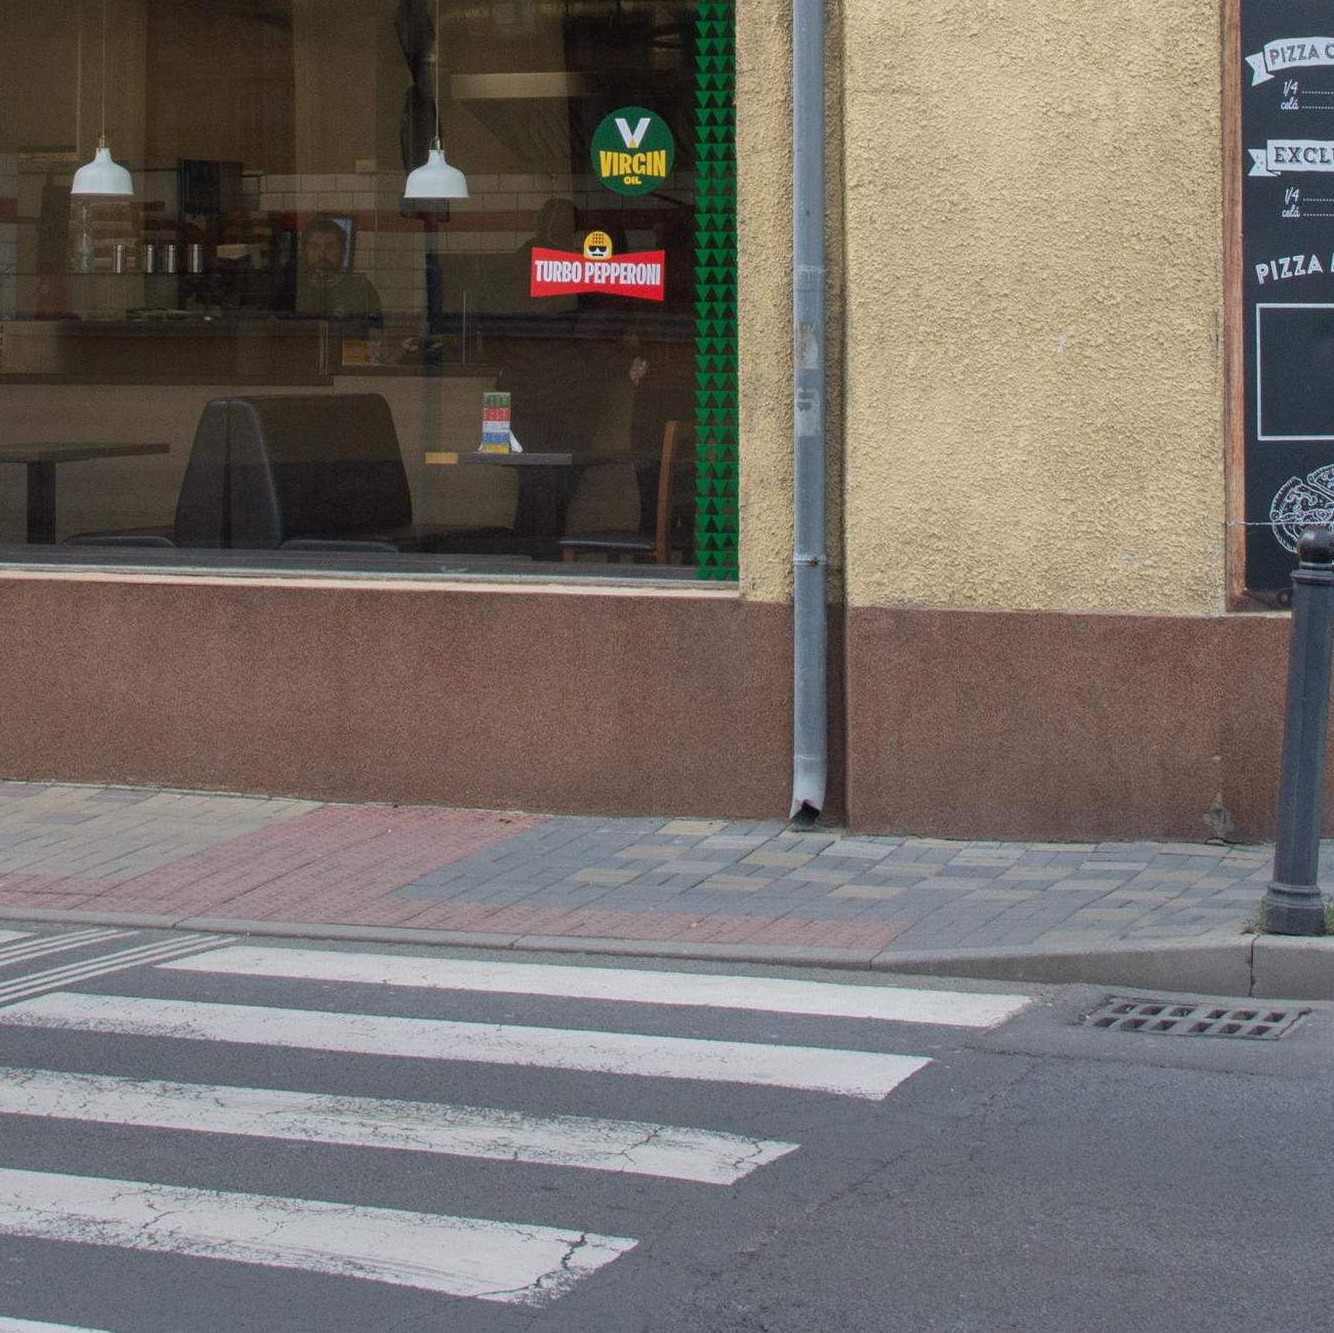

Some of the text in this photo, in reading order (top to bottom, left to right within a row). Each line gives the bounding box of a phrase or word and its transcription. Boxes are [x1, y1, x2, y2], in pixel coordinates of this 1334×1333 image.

[1269, 43, 1320, 66] PIZZA
[1281, 97, 1300, 111] celá
[599, 149, 667, 179] VIRGIN
[623, 176, 642, 186] OIL
[1281, 204, 1301, 218] celá
[534, 259, 662, 287] TURBO PEPPERONI
[1255, 254, 1324, 285] PIZZA
